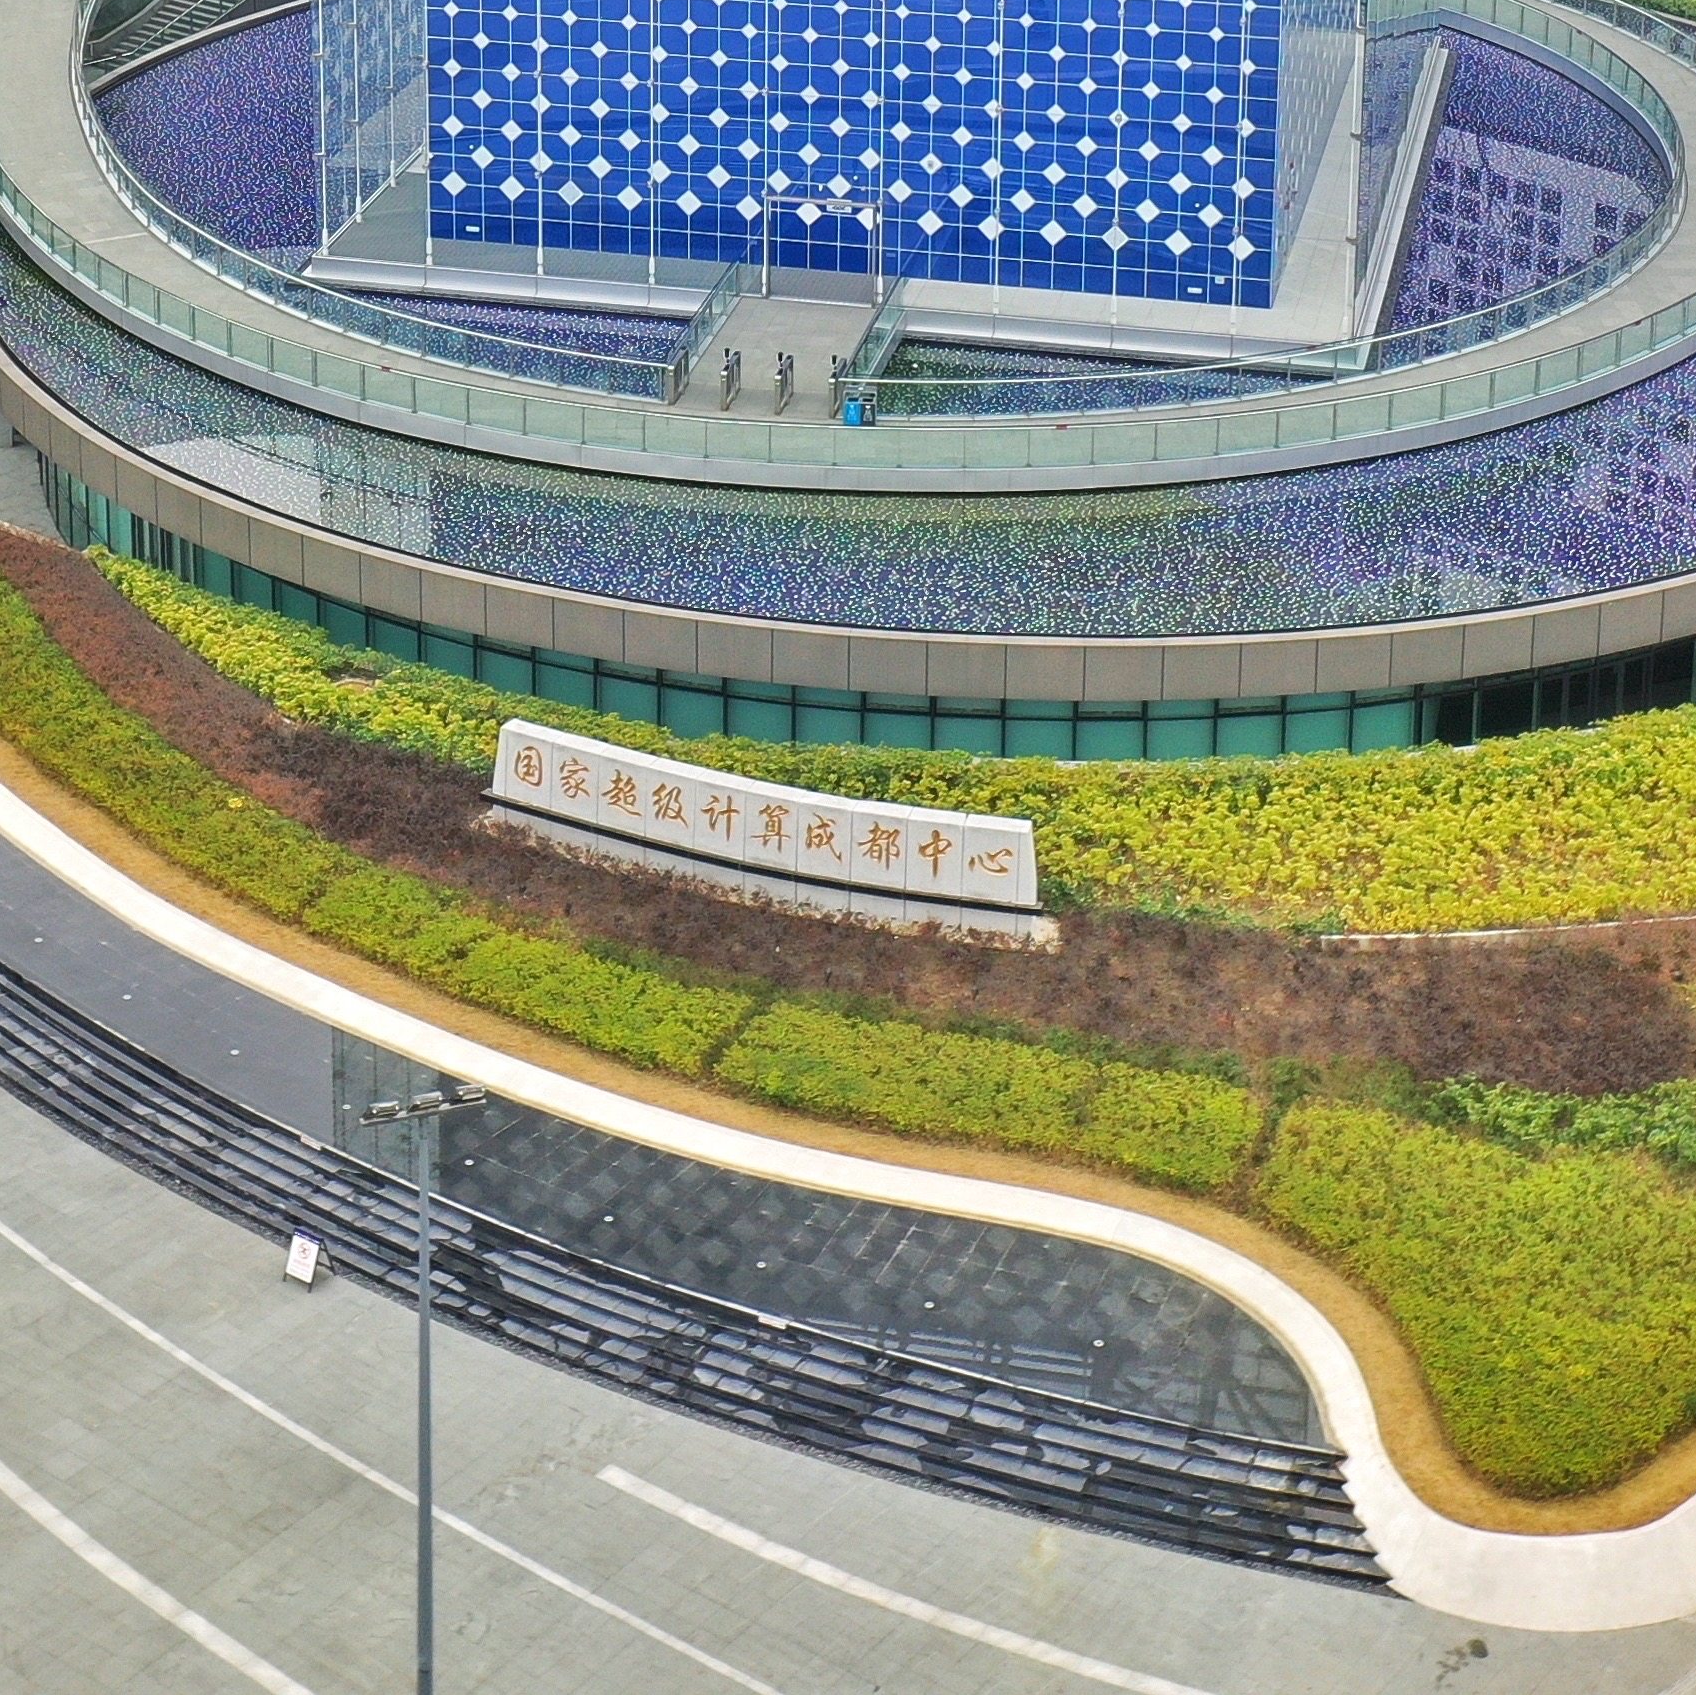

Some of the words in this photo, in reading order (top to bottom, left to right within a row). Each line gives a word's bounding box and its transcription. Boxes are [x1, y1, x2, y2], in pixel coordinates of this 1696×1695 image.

[512, 745, 1015, 878] 国家超级计算成都中心
